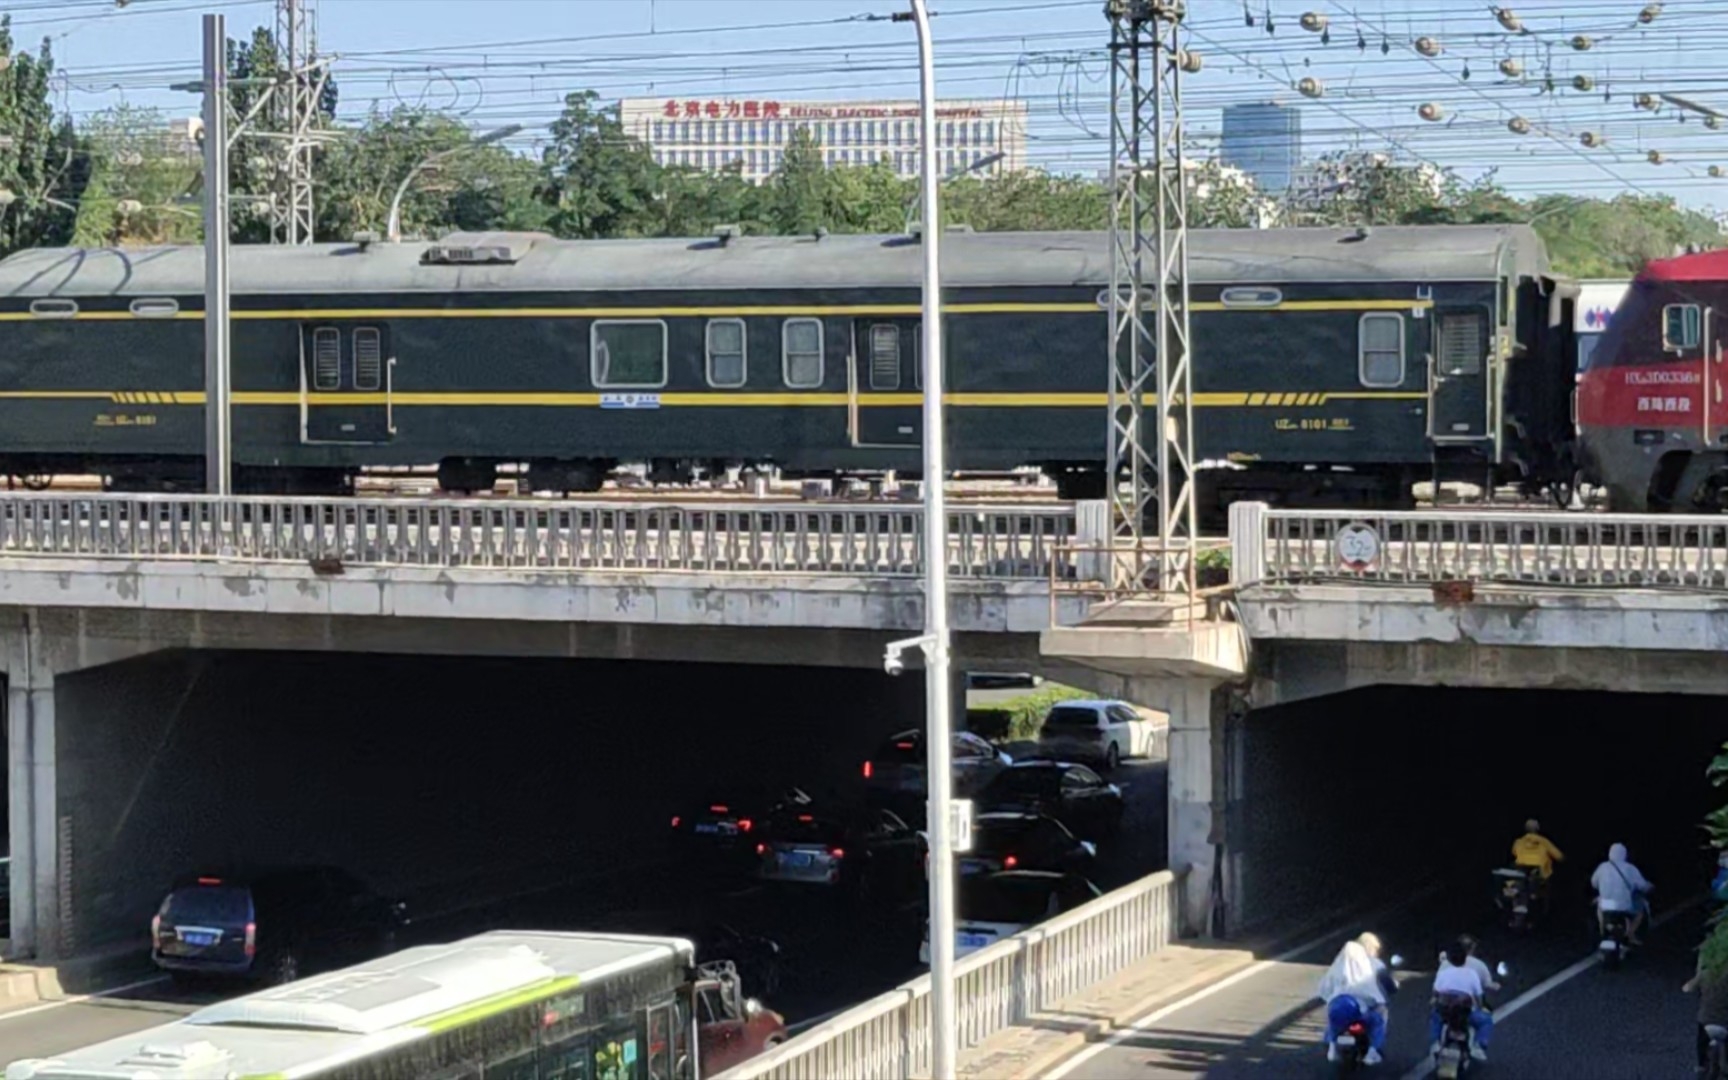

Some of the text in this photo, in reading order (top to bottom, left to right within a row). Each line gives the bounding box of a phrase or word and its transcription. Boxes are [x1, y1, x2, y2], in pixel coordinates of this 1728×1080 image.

[664, 100, 780, 118] 北京电力医院
[837, 107, 888, 118] ELECTRIC
